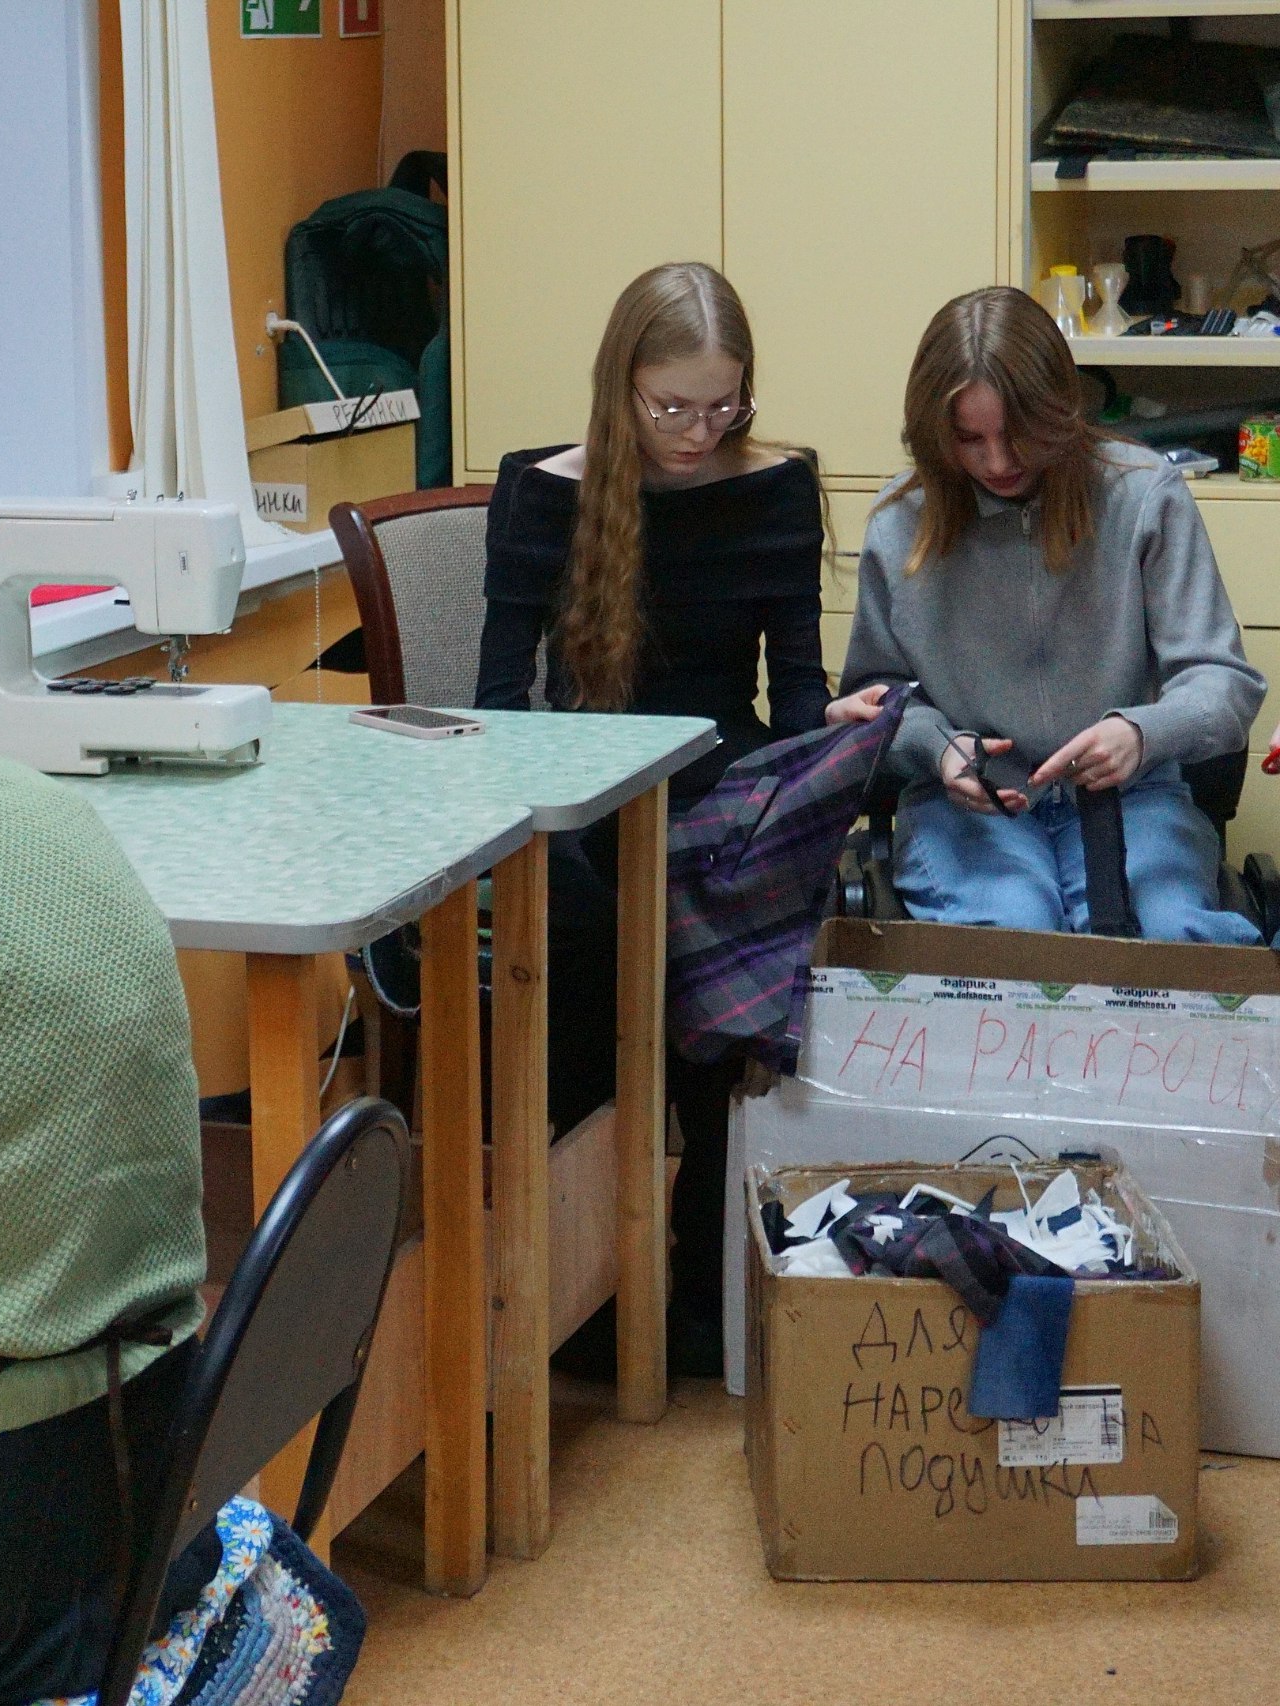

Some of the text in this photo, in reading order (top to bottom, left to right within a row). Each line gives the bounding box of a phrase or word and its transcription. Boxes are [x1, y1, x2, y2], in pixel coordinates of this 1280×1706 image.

[1105, 999, 1176, 1010] www.dofshoes.ru
[838, 1011, 926, 1094] НА
[852, 1302, 969, 1370] ДЛЯ
